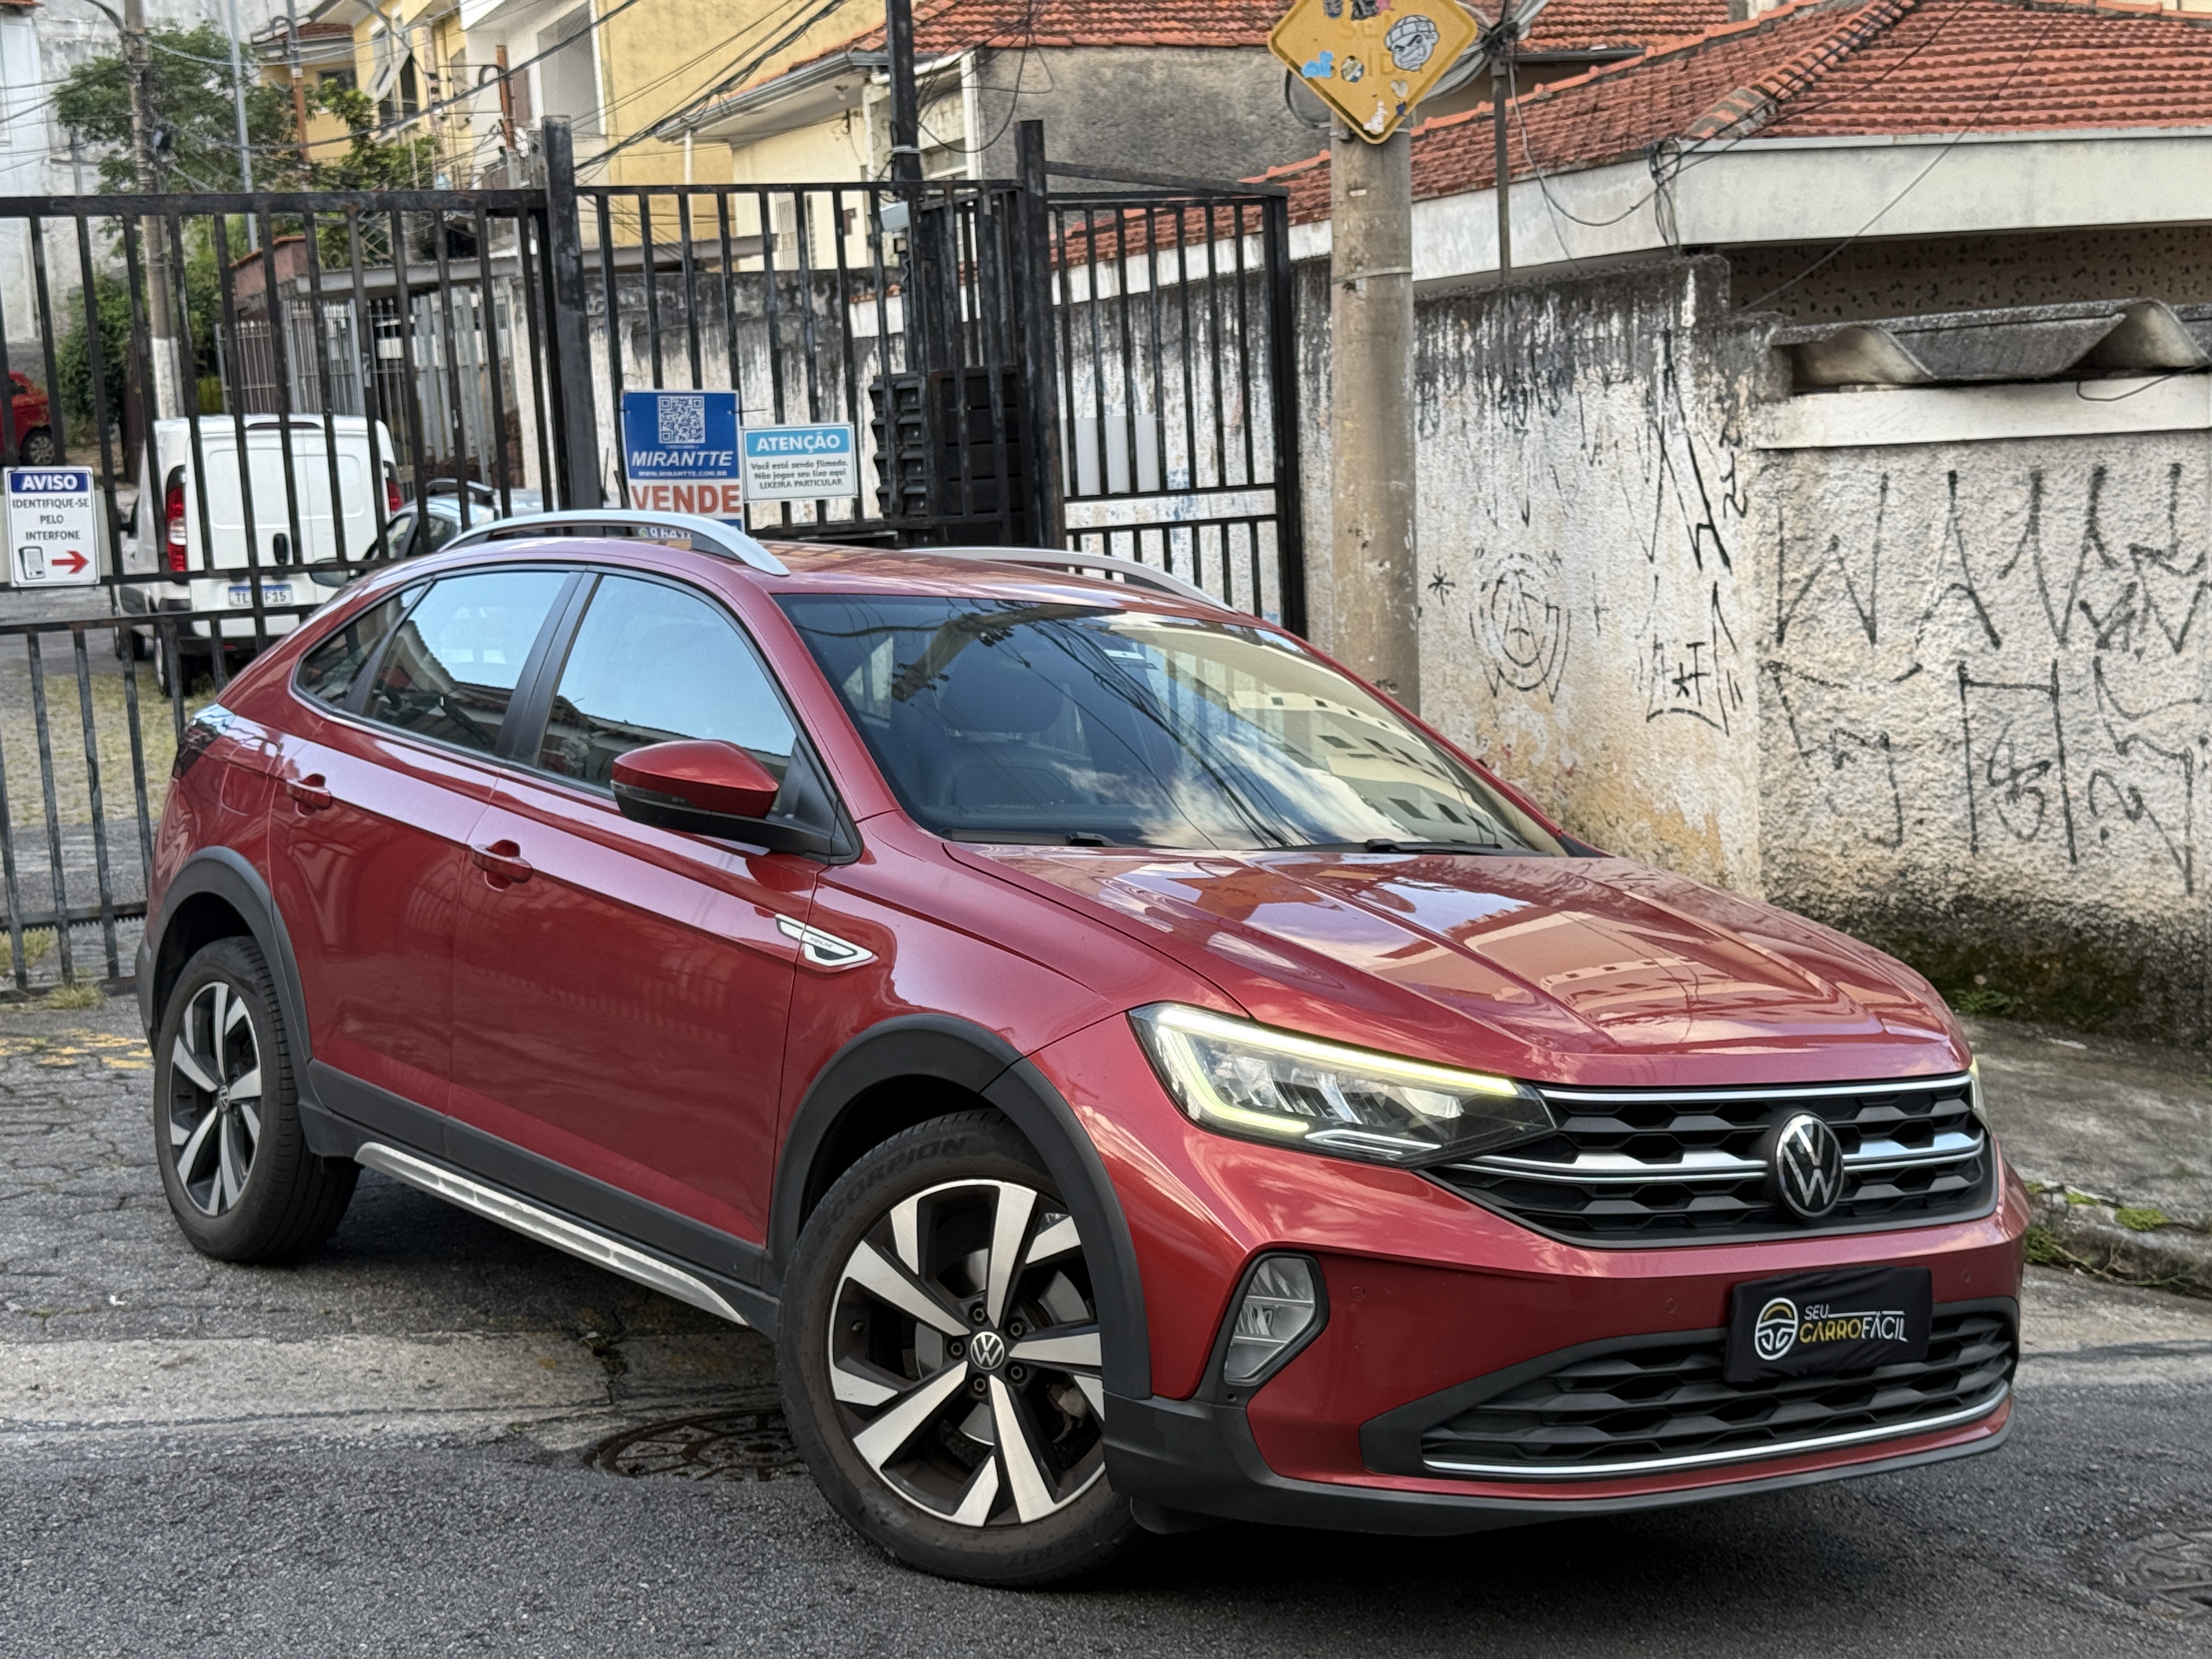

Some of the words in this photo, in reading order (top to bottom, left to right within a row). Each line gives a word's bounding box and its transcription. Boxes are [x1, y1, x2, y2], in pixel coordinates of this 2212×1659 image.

[757, 432, 841, 453] ATENÇÃO
[632, 451, 733, 466] MIRANTTE
[750, 461, 770, 470] Você
[772, 460, 789, 469] está
[791, 460, 814, 469] sendo
[816, 459, 848, 469] filmado.
[773, 471, 795, 481] jogue
[21, 474, 78, 490] AVISO
[760, 481, 792, 489] LIXEIRA
[794, 479, 843, 488] PARTICULAR
[12, 498, 89, 509] IDENTIFIQUE-SE
[631, 484, 741, 514] VENDE
[40, 515, 64, 524] PELO
[26, 531, 81, 540] INTERFONE
[1804, 1304, 1830, 1321] SEU
